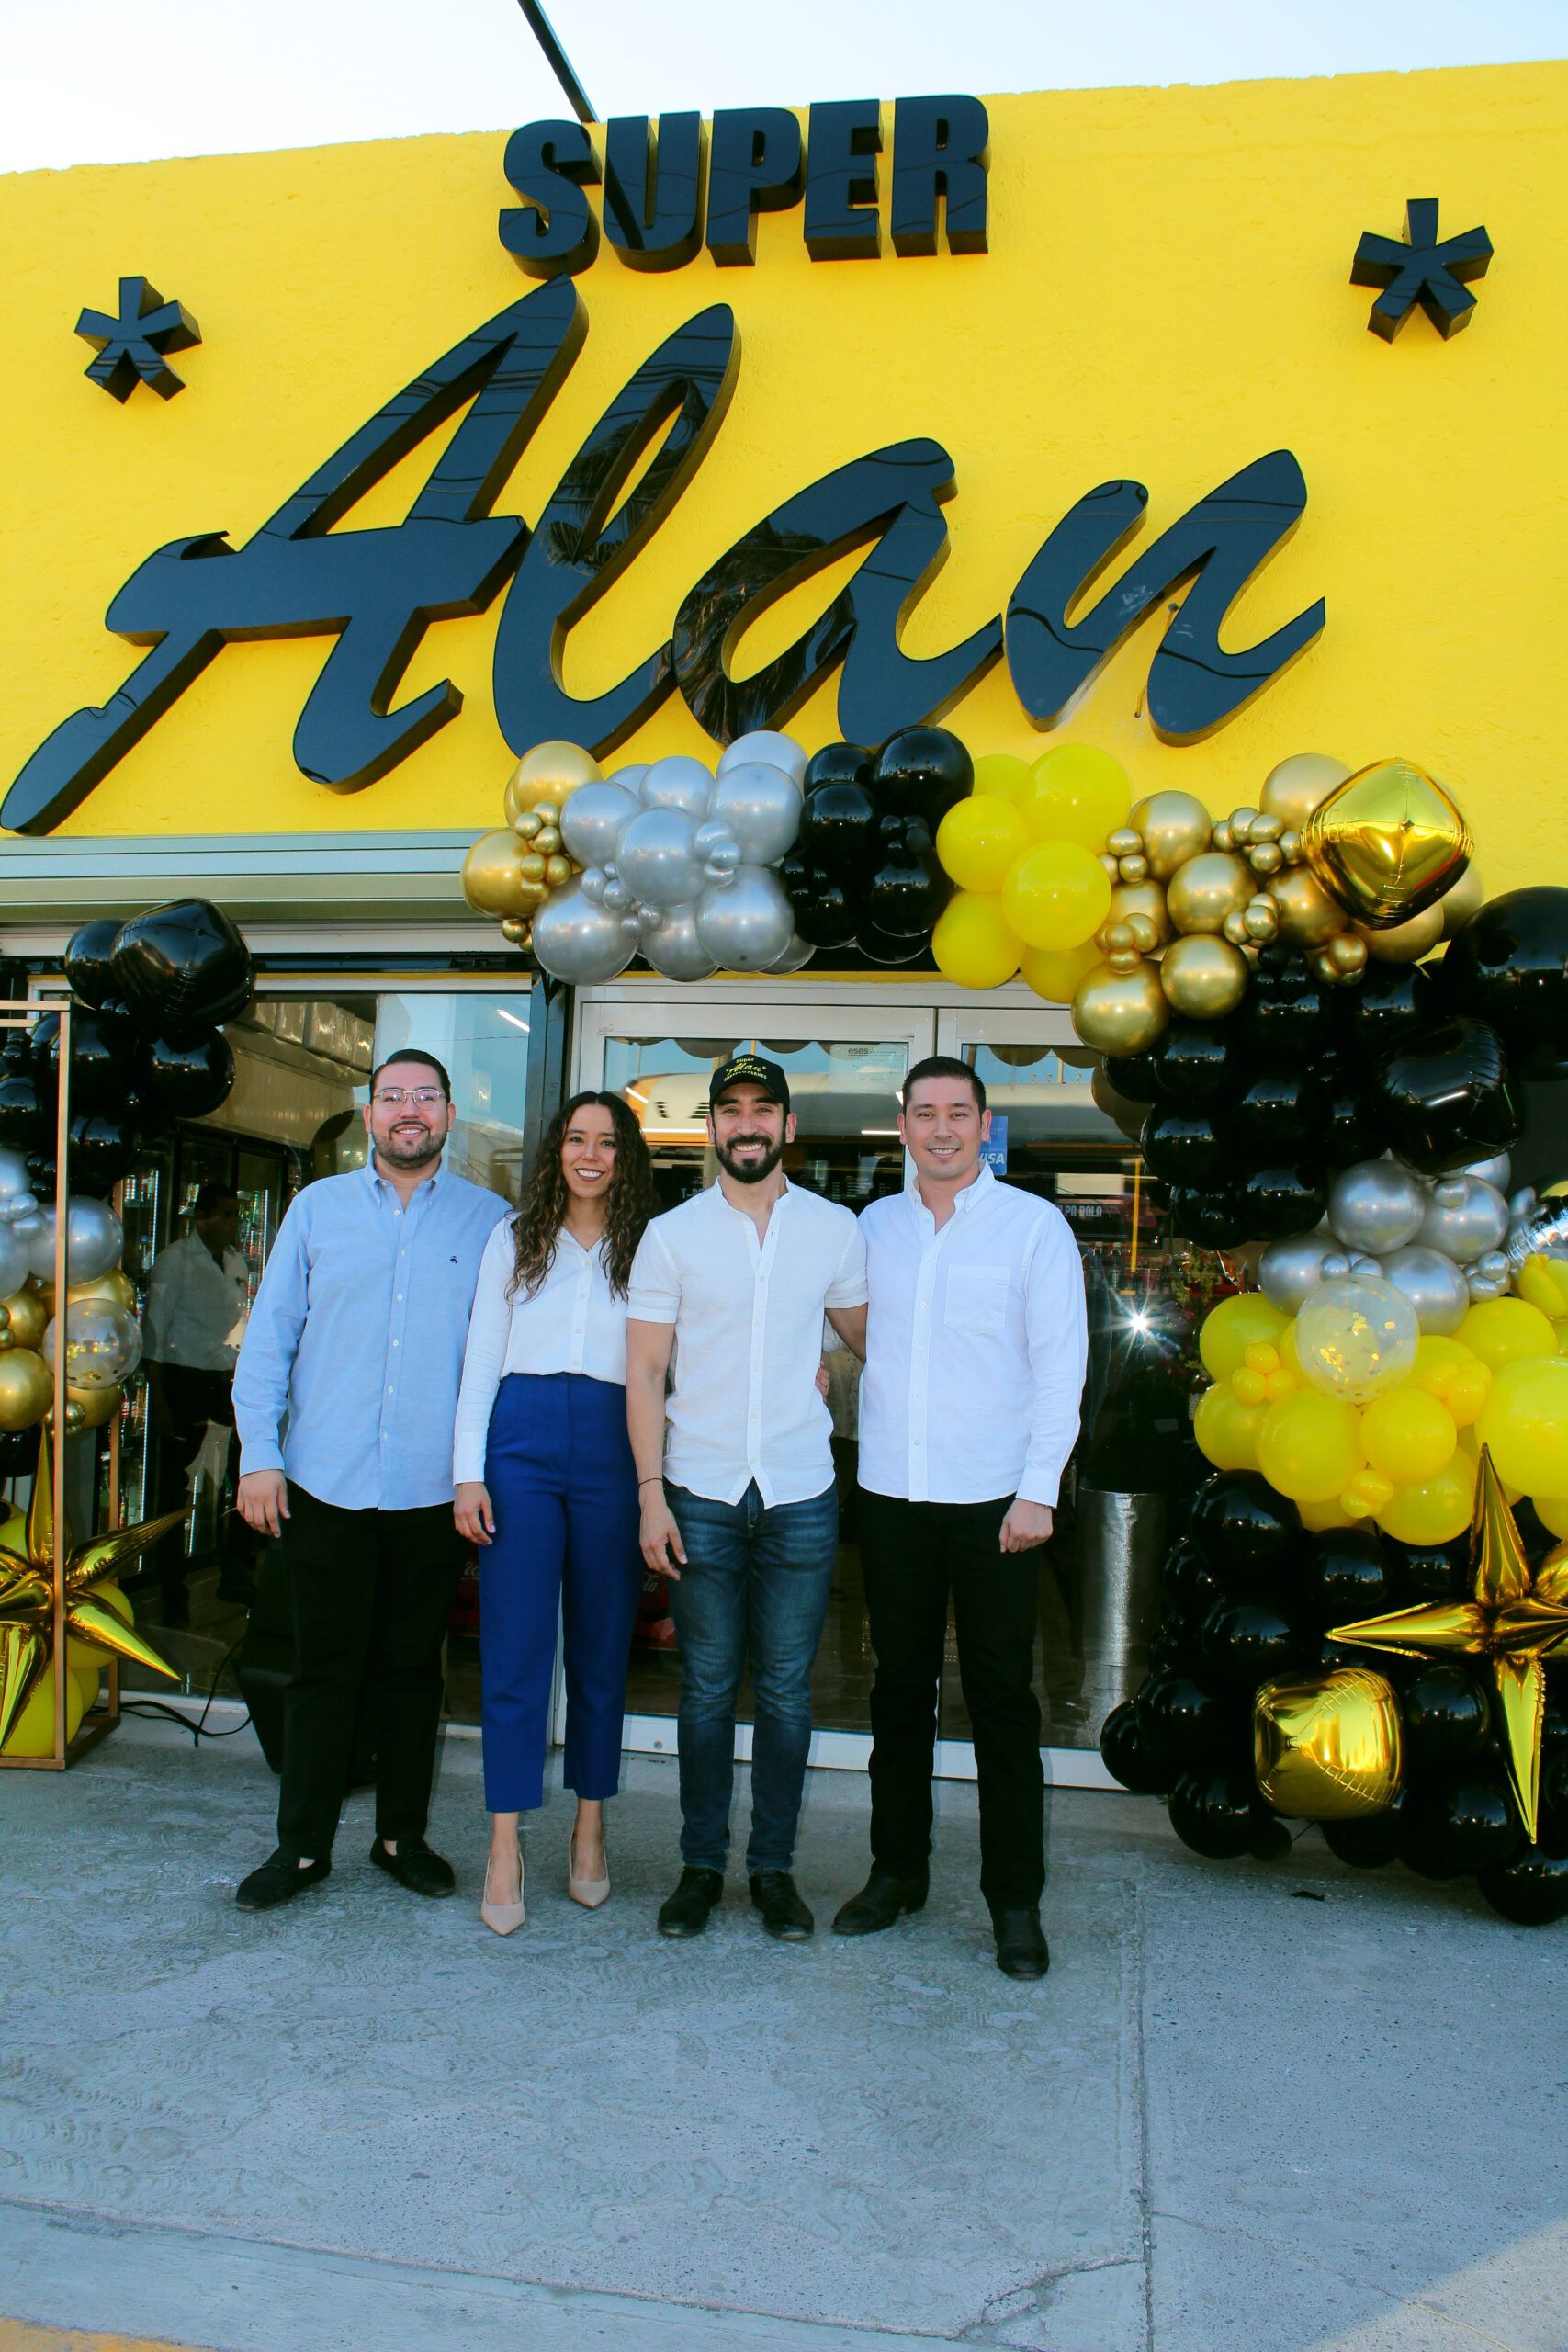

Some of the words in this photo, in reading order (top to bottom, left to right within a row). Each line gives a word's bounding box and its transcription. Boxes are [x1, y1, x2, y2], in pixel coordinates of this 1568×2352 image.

[499, 94, 990, 280] SUPER
[1, 275, 1325, 834] Alan
[727, 1062, 761, 1076] Alan
